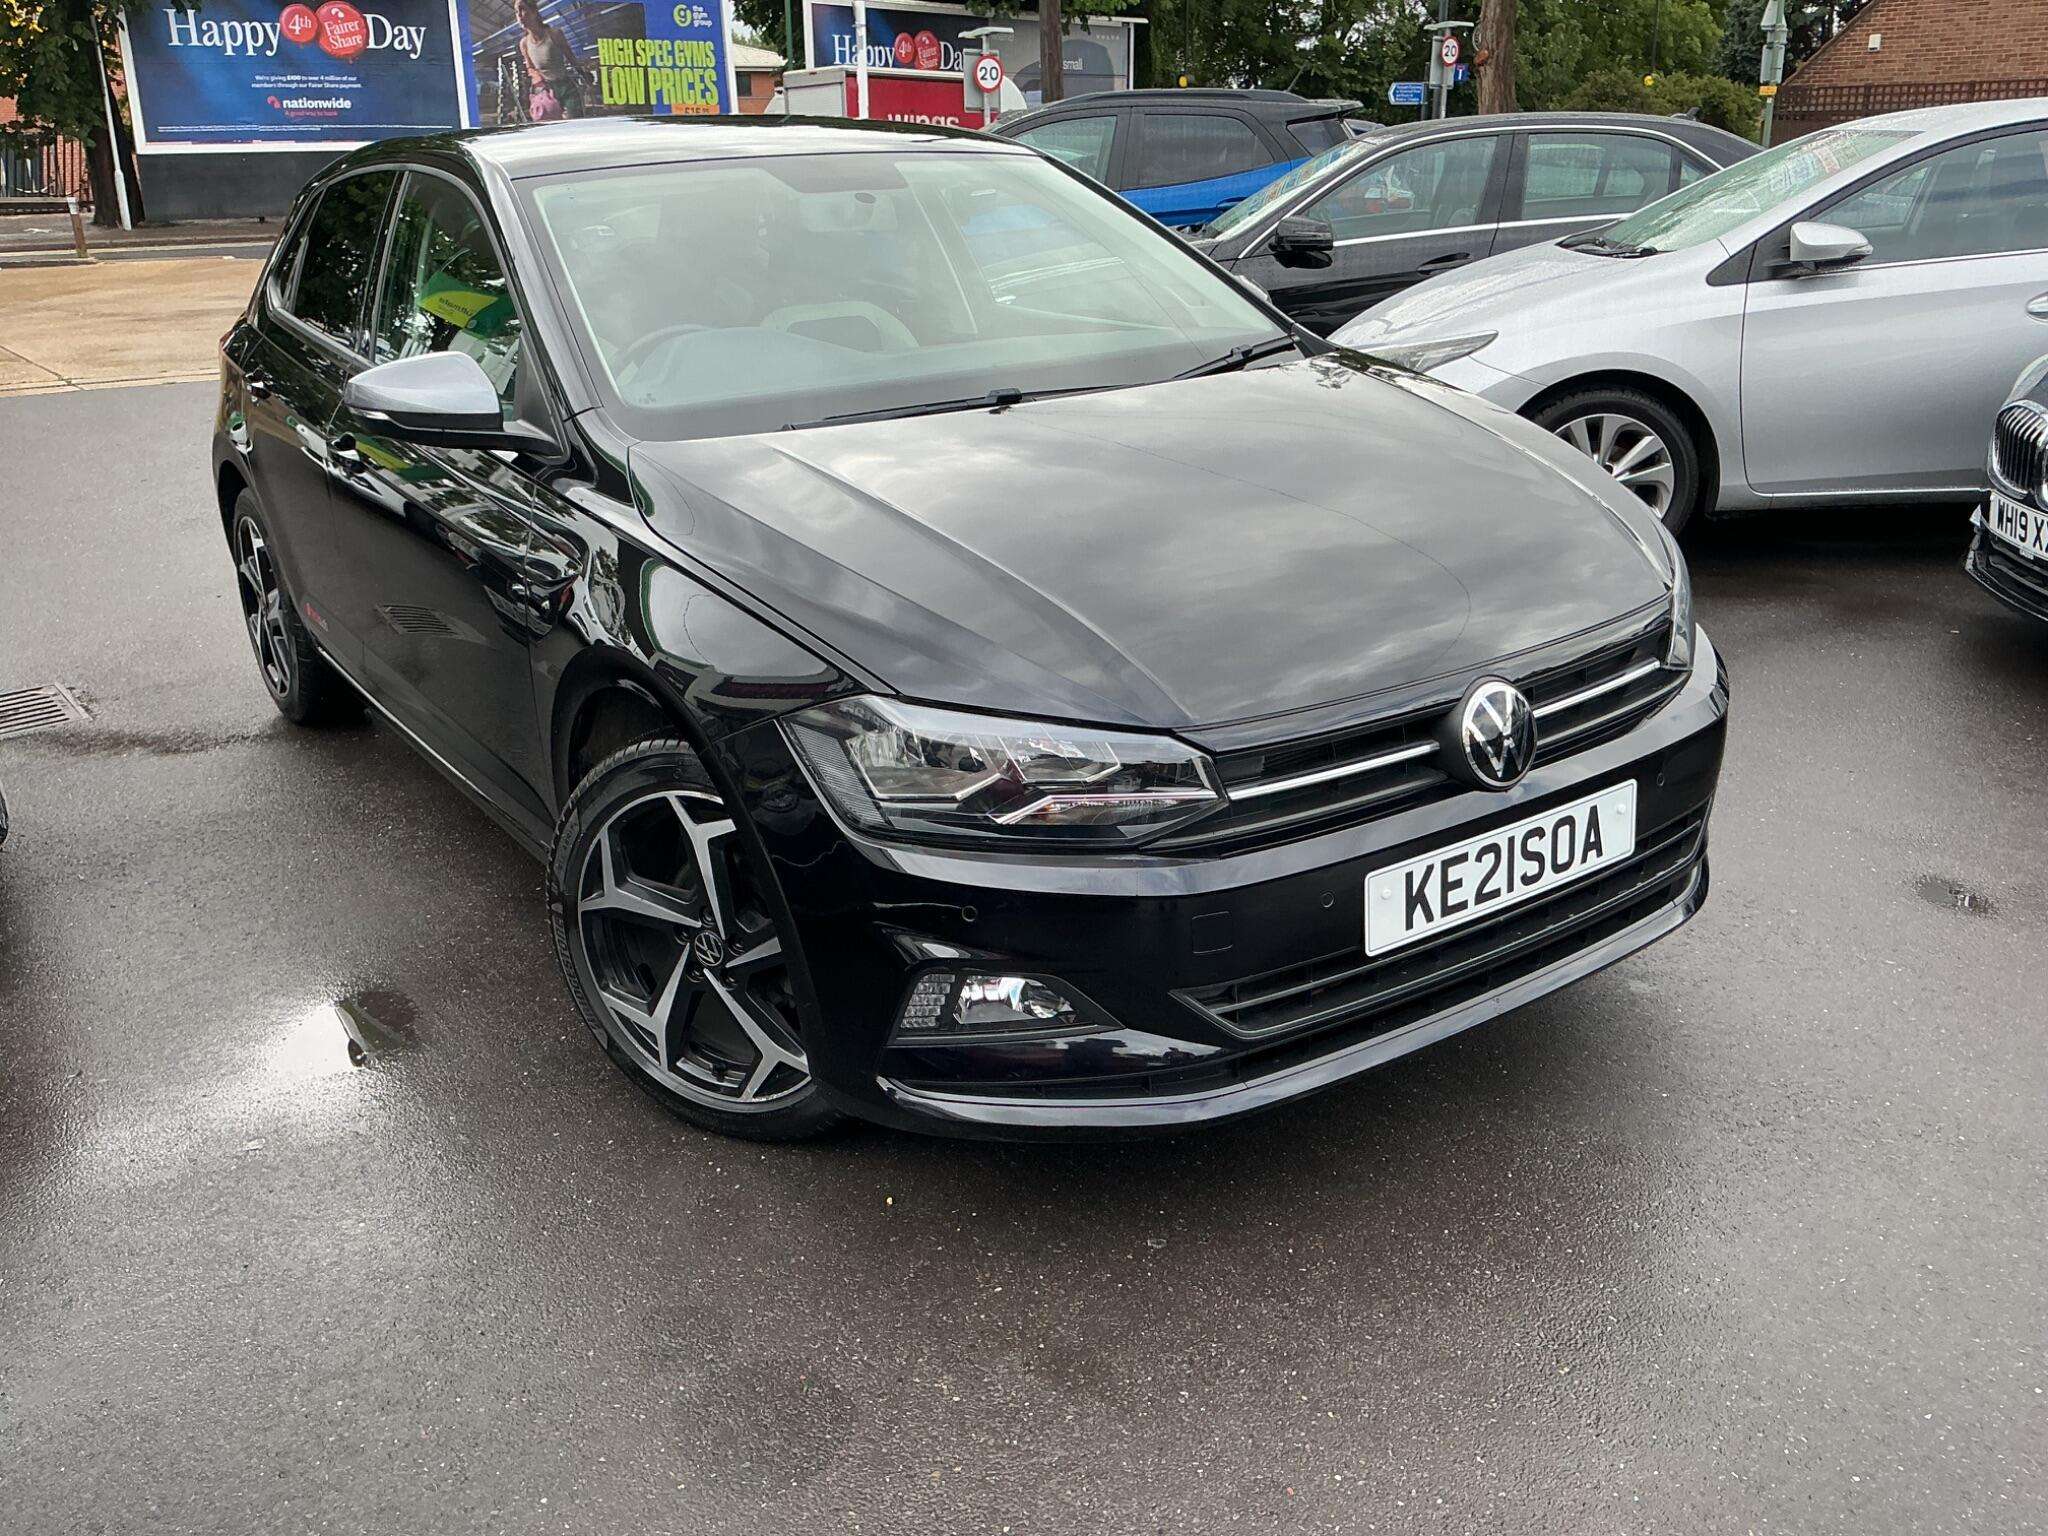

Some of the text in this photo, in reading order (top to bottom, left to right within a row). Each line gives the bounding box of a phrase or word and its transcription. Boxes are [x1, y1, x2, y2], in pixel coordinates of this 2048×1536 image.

[325, 19, 361, 37] Fairer
[693, 19, 712, 28] group
[162, 8, 427, 60] Happy 4th Day
[329, 34, 363, 50] Share
[597, 38, 716, 68] HIGH SPEC GYMS
[940, 41, 963, 71] Da
[1443, 45, 1457, 57] 20
[1062, 58, 1083, 70] small
[979, 66, 999, 81] 20
[600, 66, 719, 105] LOW PRICES
[282, 97, 351, 109] nationwide
[1996, 498, 2048, 552] WH19 X
[1404, 804, 1603, 931] KE21SOA
